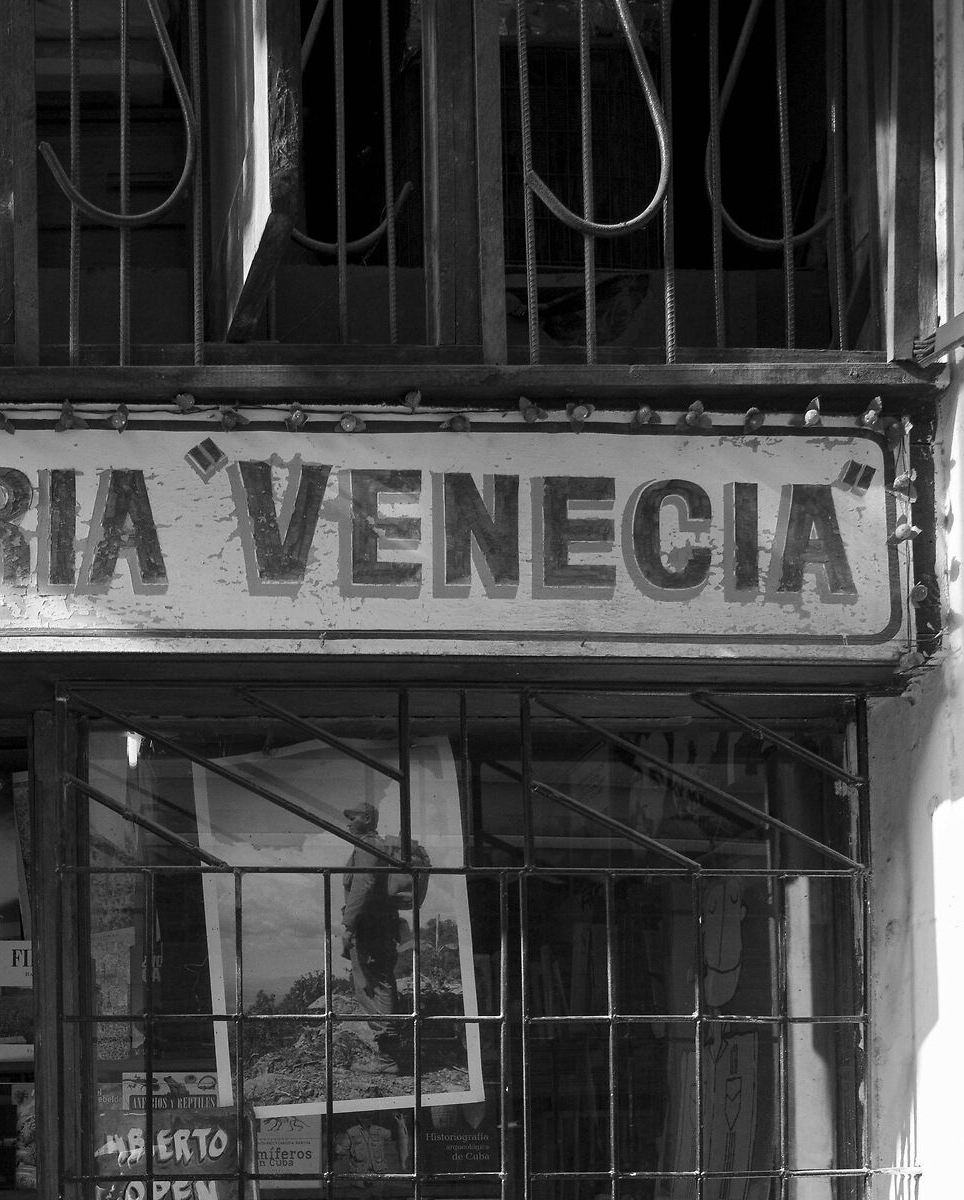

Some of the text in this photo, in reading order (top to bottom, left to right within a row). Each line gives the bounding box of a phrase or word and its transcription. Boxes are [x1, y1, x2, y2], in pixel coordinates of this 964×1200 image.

[12, 949, 32, 967] FI
[134, 1097, 168, 1109] ANFIOS
[177, 1097, 216, 1109] REPTILES
[104, 1128, 228, 1162] ABERTO
[257, 1147, 313, 1160] míferos
[452, 1152, 490, 1160] de Cuba
